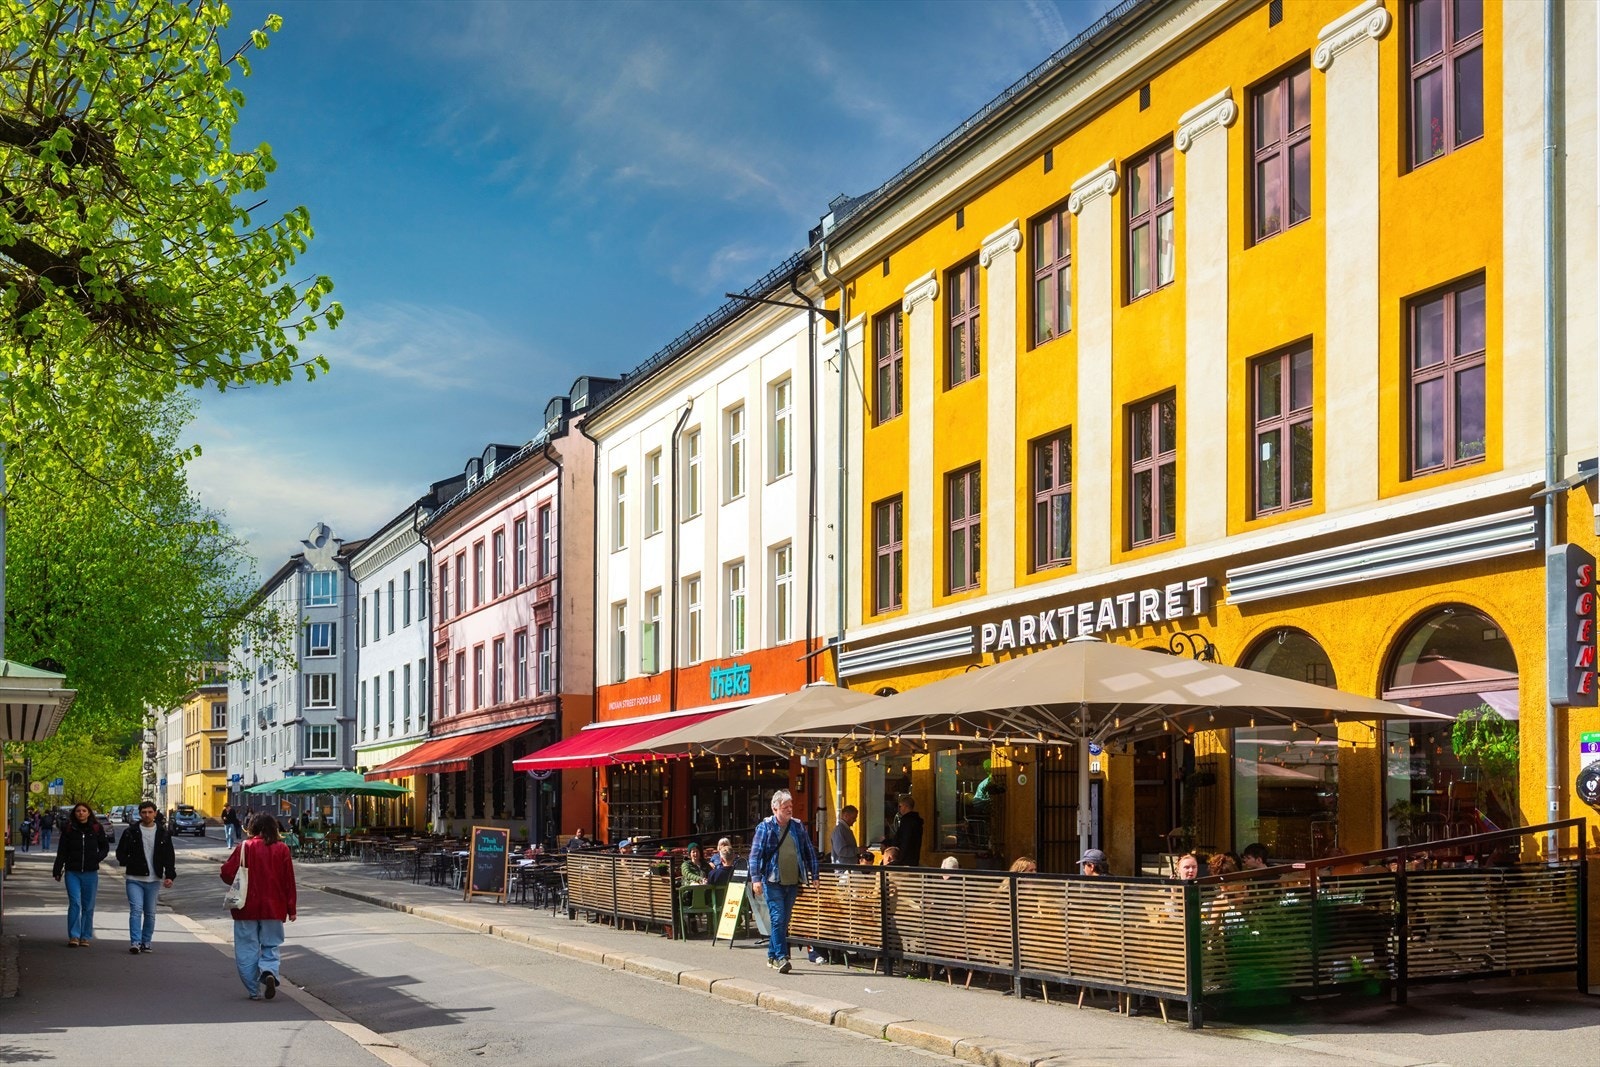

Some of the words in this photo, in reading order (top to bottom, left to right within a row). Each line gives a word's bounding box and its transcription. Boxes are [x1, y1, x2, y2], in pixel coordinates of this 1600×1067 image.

[981, 577, 1209, 653] PARKTEATRET
[1577, 564, 1595, 694] SCENE
[608, 701, 622, 711] INDIAN
[622, 698, 636, 708] STREET
[636, 696, 648, 706] FOOD
[652, 694, 662, 703] BAR
